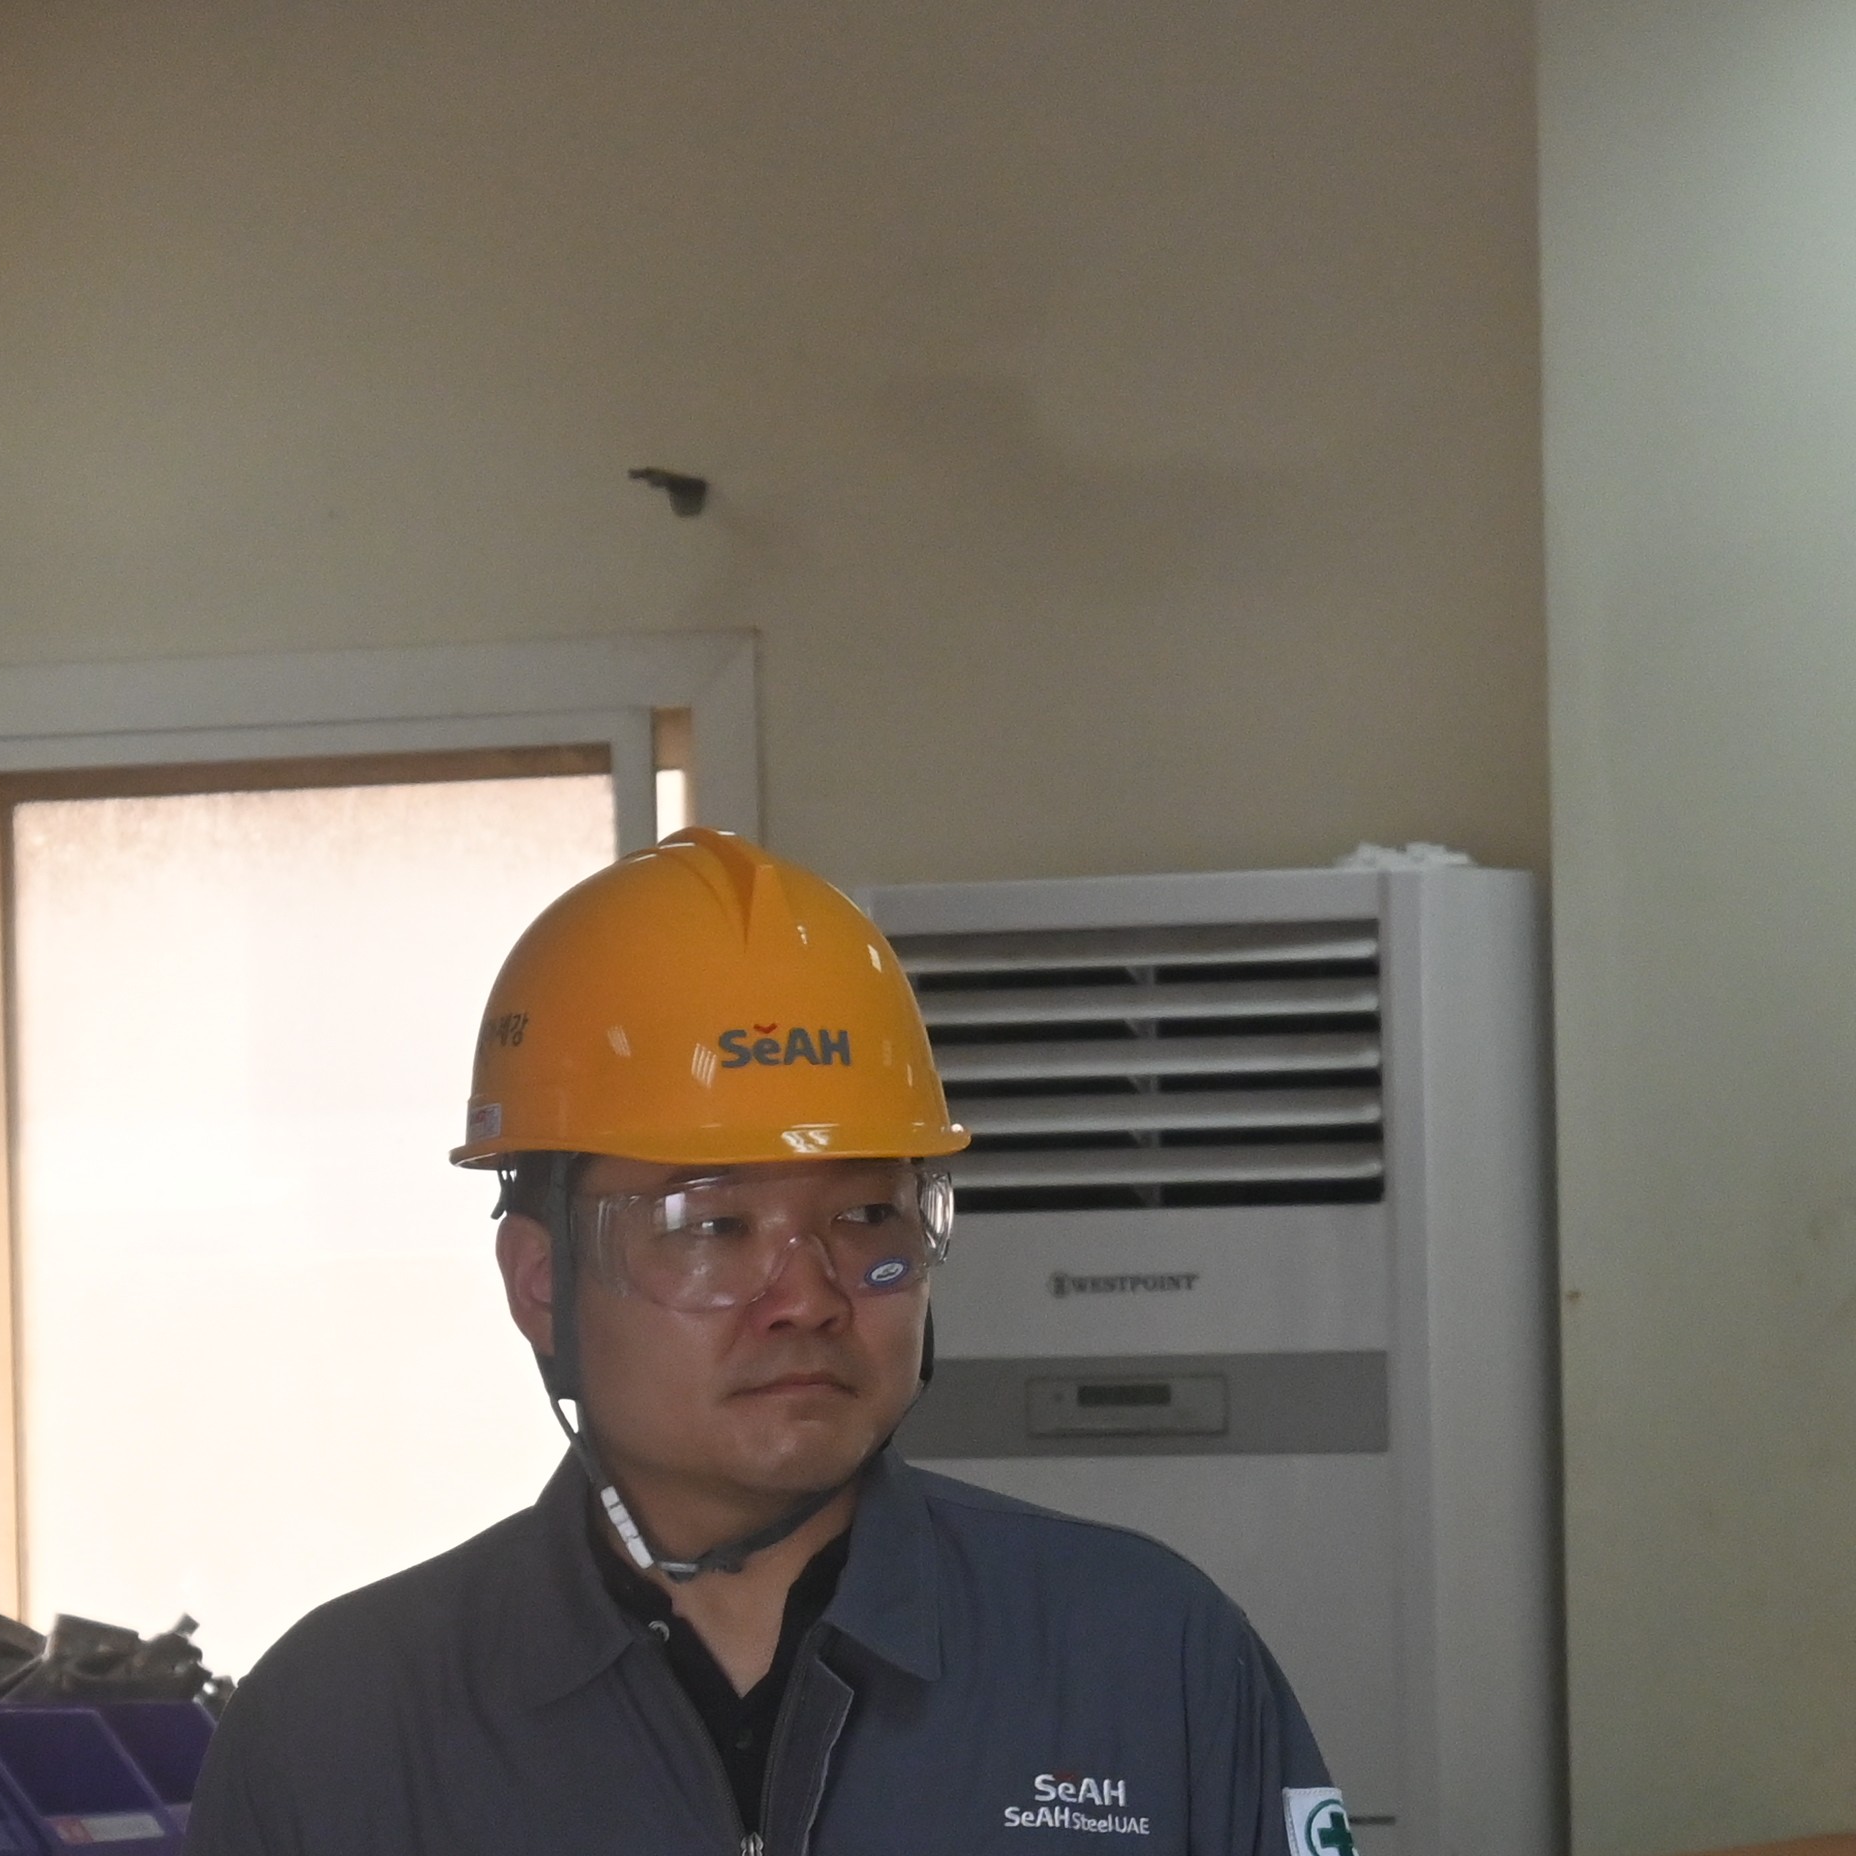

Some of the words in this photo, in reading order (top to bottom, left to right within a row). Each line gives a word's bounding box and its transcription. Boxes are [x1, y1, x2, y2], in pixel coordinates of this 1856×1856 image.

[718, 1023, 852, 1068] SeAH
[1071, 1273, 1199, 1295] WESTPOINT
[1034, 1772, 1128, 1808] SeAH
[1004, 1805, 1071, 1829] SeAH
[1072, 1811, 1113, 1833] Steel
[1114, 1815, 1151, 1836] UAE
